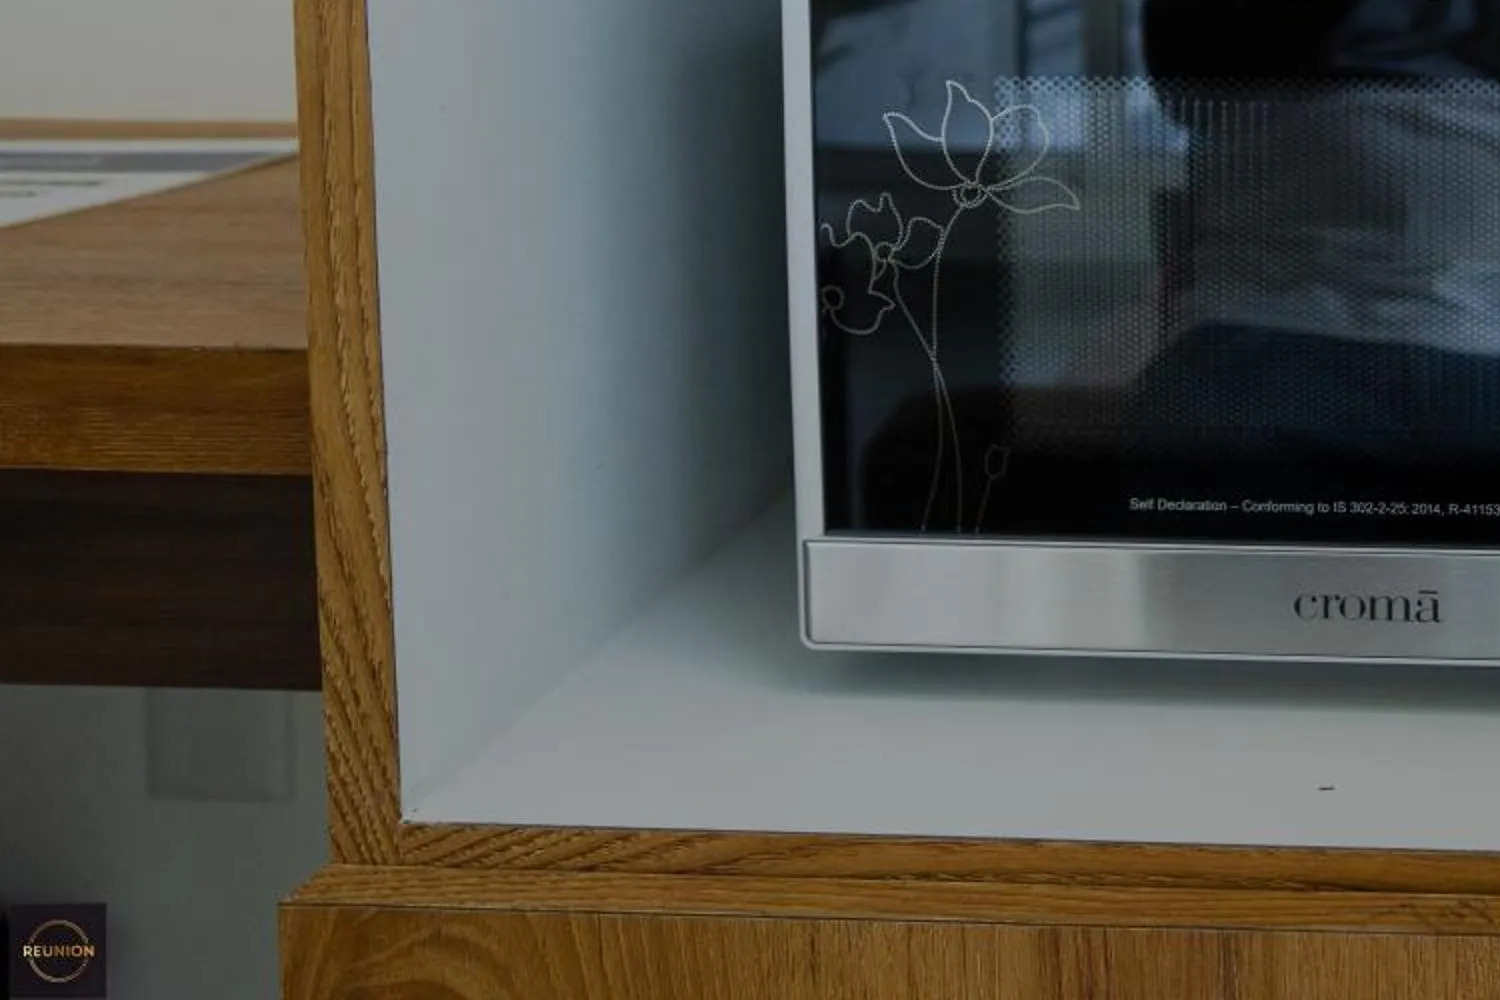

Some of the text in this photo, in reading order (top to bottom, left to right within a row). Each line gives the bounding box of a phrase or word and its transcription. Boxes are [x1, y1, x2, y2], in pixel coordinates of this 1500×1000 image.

[1129, 497, 1154, 511] Self
[1157, 497, 1227, 511] Declaration
[1241, 499, 1314, 516] Conforming
[1317, 501, 1330, 513] to
[1333, 501, 1346, 514] IS
